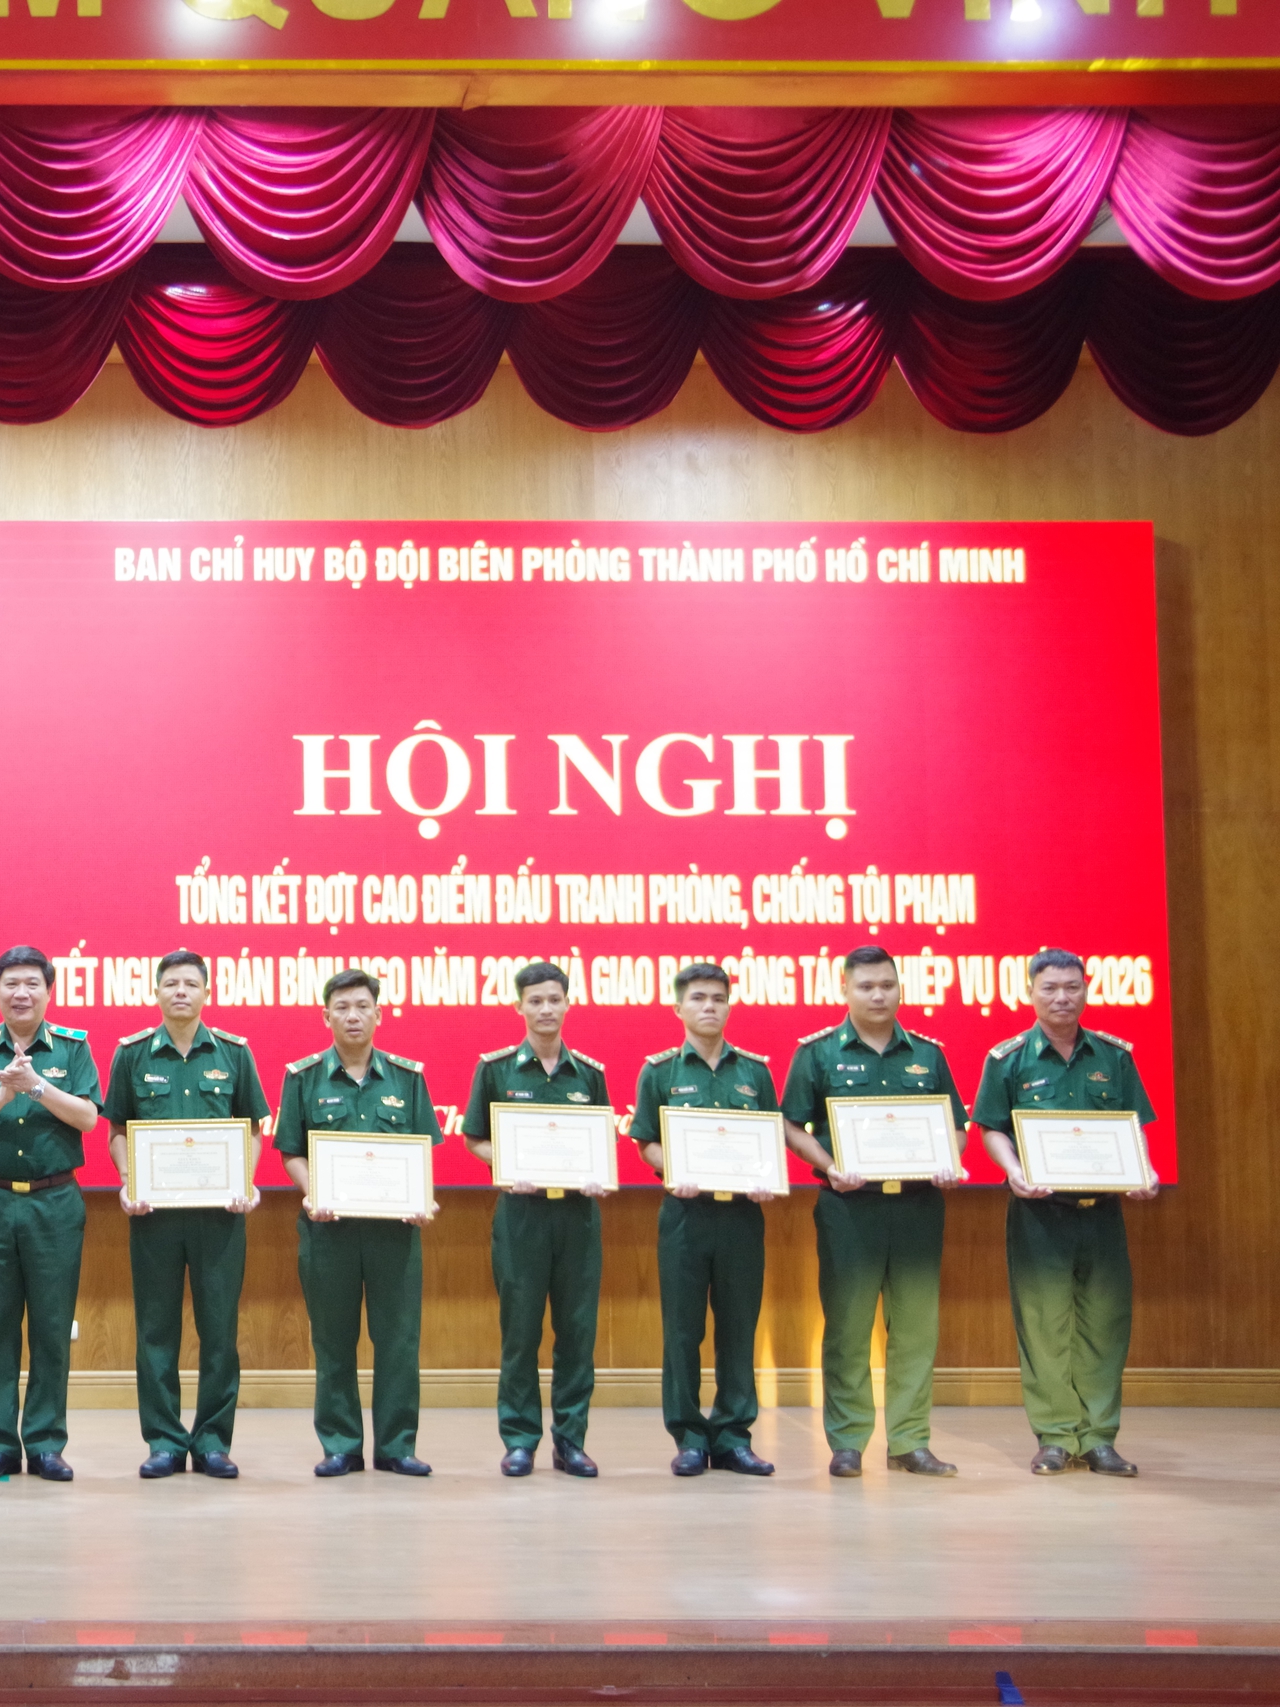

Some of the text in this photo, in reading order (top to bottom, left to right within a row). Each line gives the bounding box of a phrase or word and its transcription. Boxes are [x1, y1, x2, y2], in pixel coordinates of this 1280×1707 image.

[114, 535, 1025, 589] BAN CHỈ HUY BỘ ĐỘI BIÊN PHÒNG THÀNH PHỐ HỒ CHÍ MINH
[292, 719, 857, 840] HỘI NGHỊ
[175, 854, 976, 935] TỔNG KẾT ĐỢT CAO ĐIỂM ĐẤU TRANH PHÒNG, CHỐNG TỘI PHẠM
[52, 940, 99, 1006] TẾT
[216, 947, 274, 1006] ĐÁN
[411, 946, 476, 1006] NĂM
[591, 955, 655, 1006] GIAO
[721, 946, 796, 1006] CÔNG
[892, 946, 954, 1017] HIỆP
[957, 955, 994, 1017] VỤ
